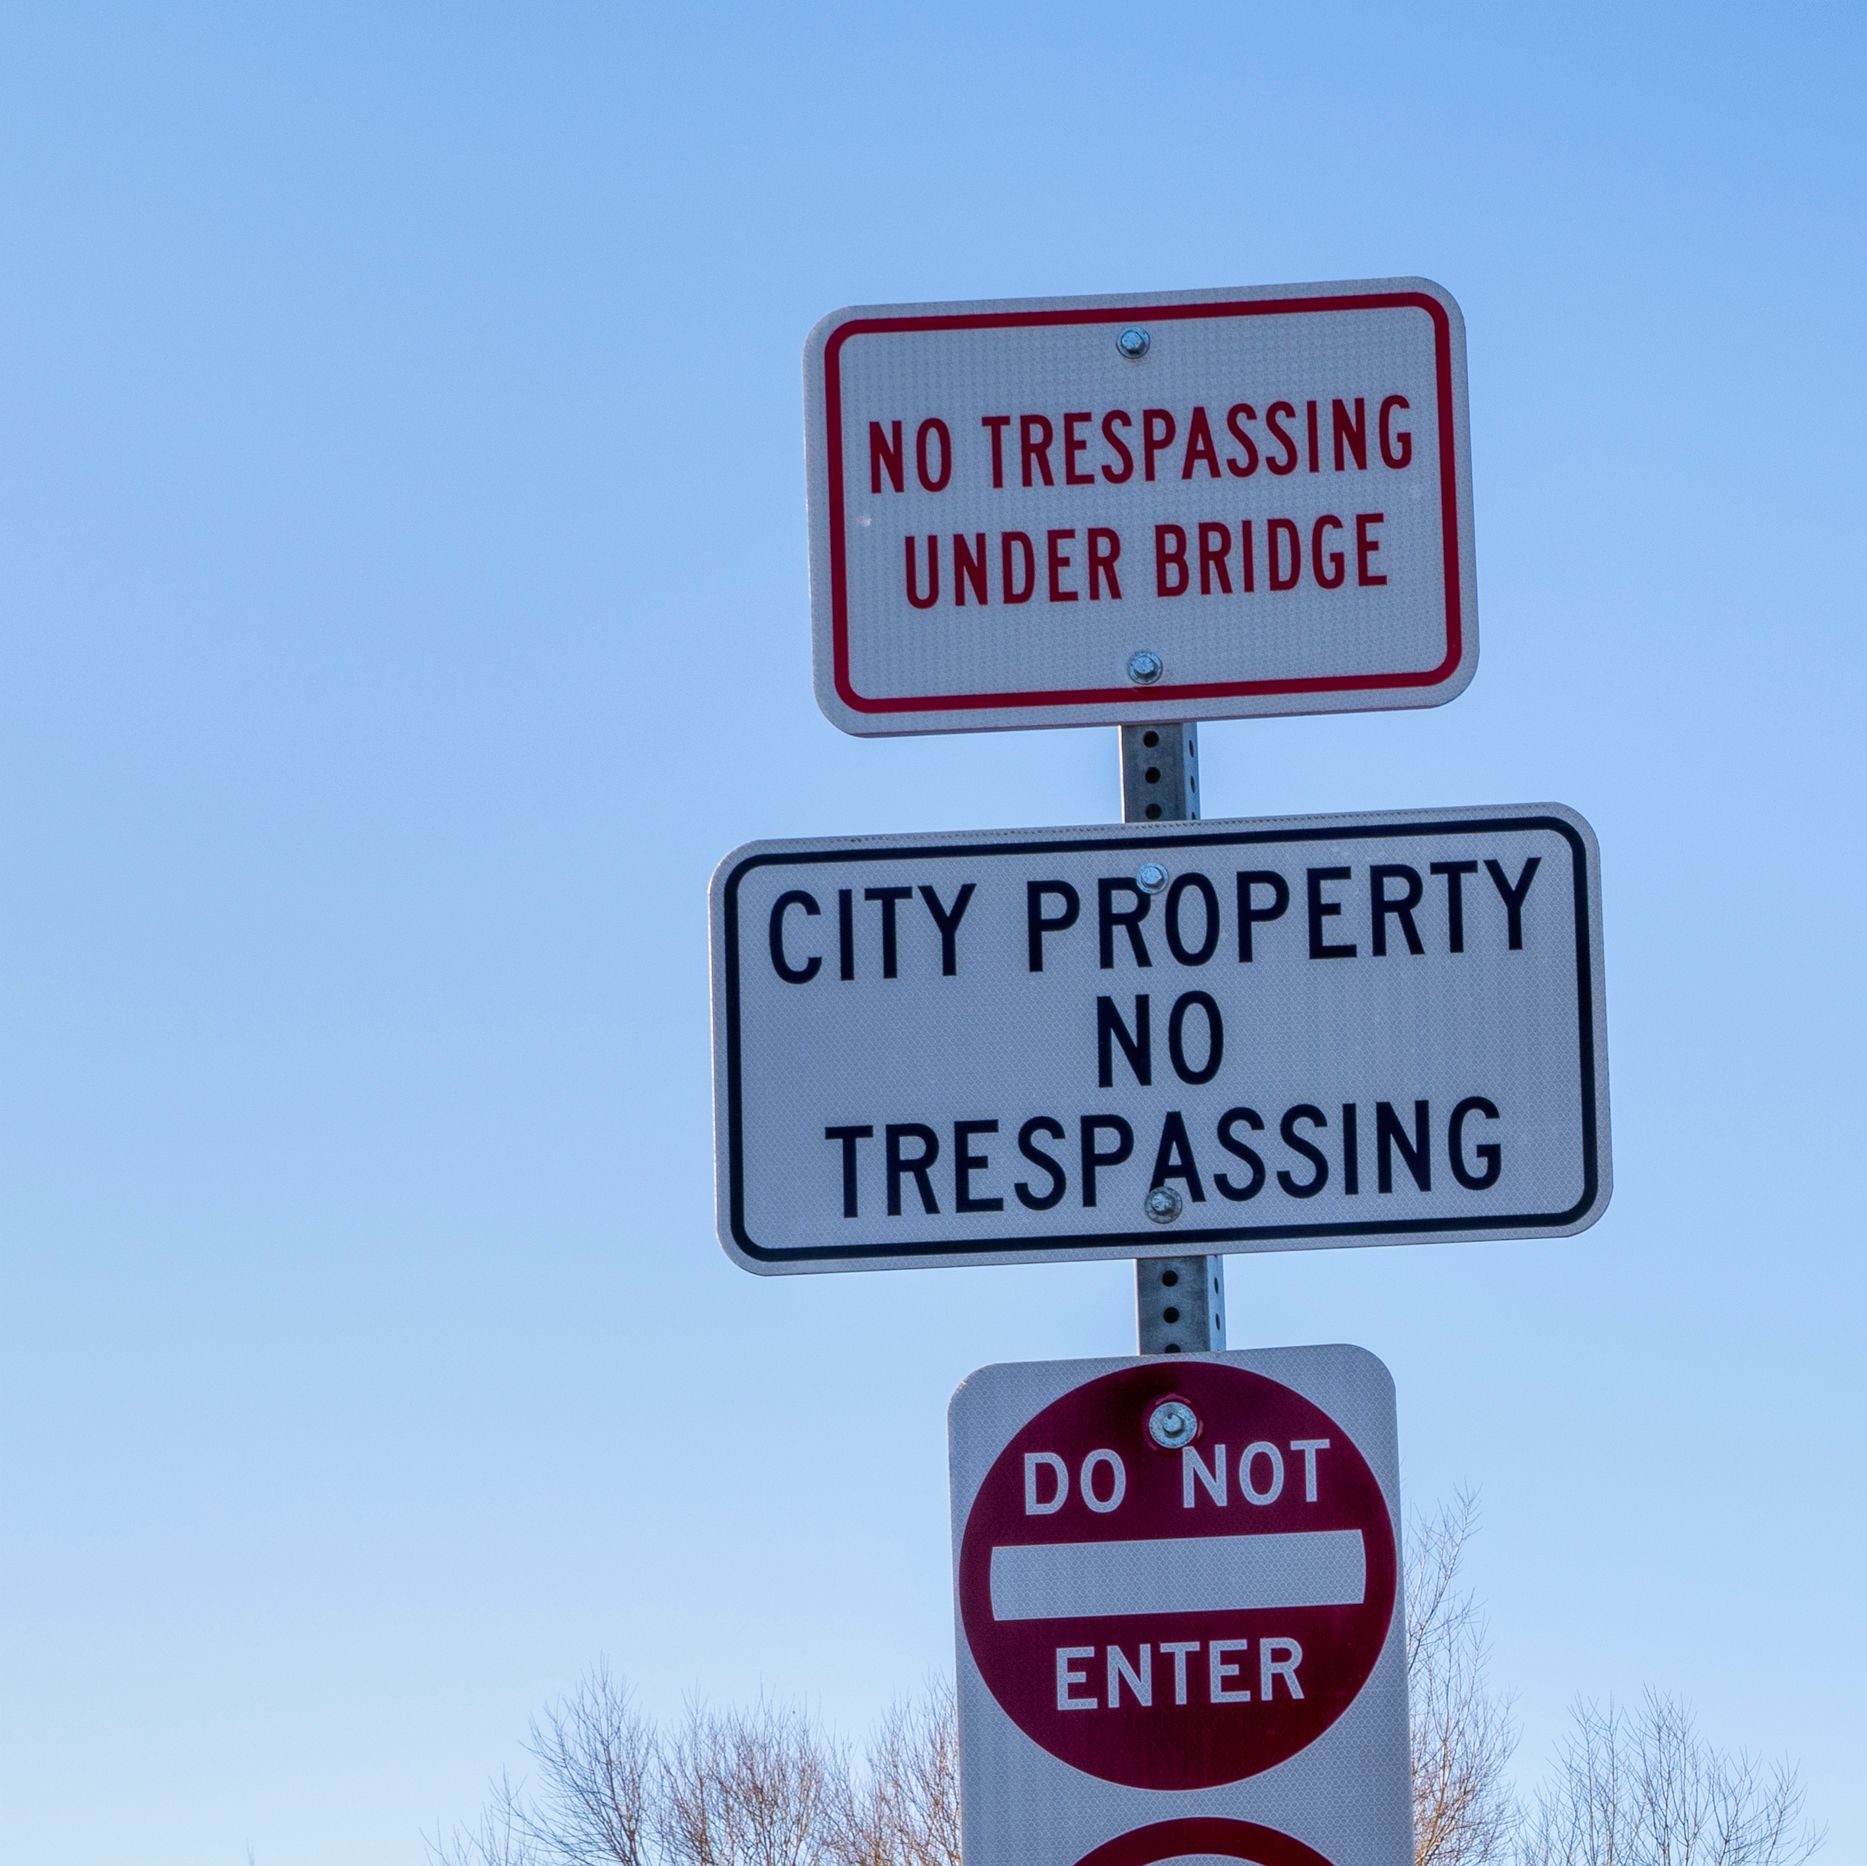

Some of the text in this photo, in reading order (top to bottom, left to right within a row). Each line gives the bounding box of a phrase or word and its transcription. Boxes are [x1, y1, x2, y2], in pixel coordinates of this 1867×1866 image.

[868, 394, 1413, 494] NO TRESPASSING
[904, 512, 1388, 610] UNDER BRIDGE
[768, 856, 1542, 985] CITY PROPERTY
[1096, 990, 1224, 1089] NO
[824, 1095, 1502, 1219] TRESPASSING
[1023, 1438, 1331, 1516] DO NOT
[1055, 1636, 1305, 1711] ENTER
